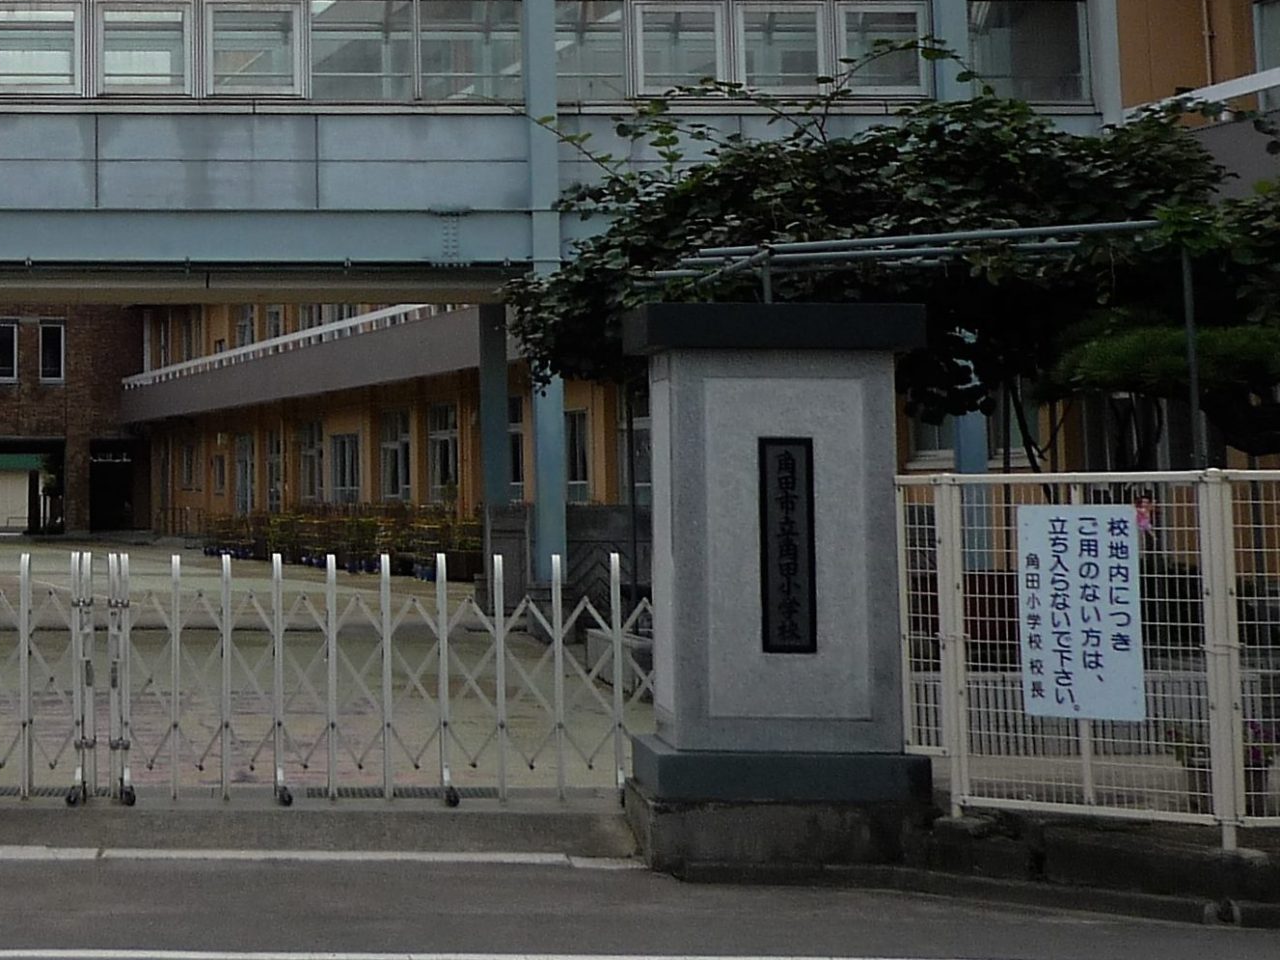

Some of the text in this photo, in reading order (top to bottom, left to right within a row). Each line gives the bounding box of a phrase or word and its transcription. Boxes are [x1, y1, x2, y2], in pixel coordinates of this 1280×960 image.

[1048, 517, 1080, 712] 立ち入らないで下さい。
[1078, 517, 1105, 682] ご用のない方は、
[1107, 518, 1131, 652] 校地内につき
